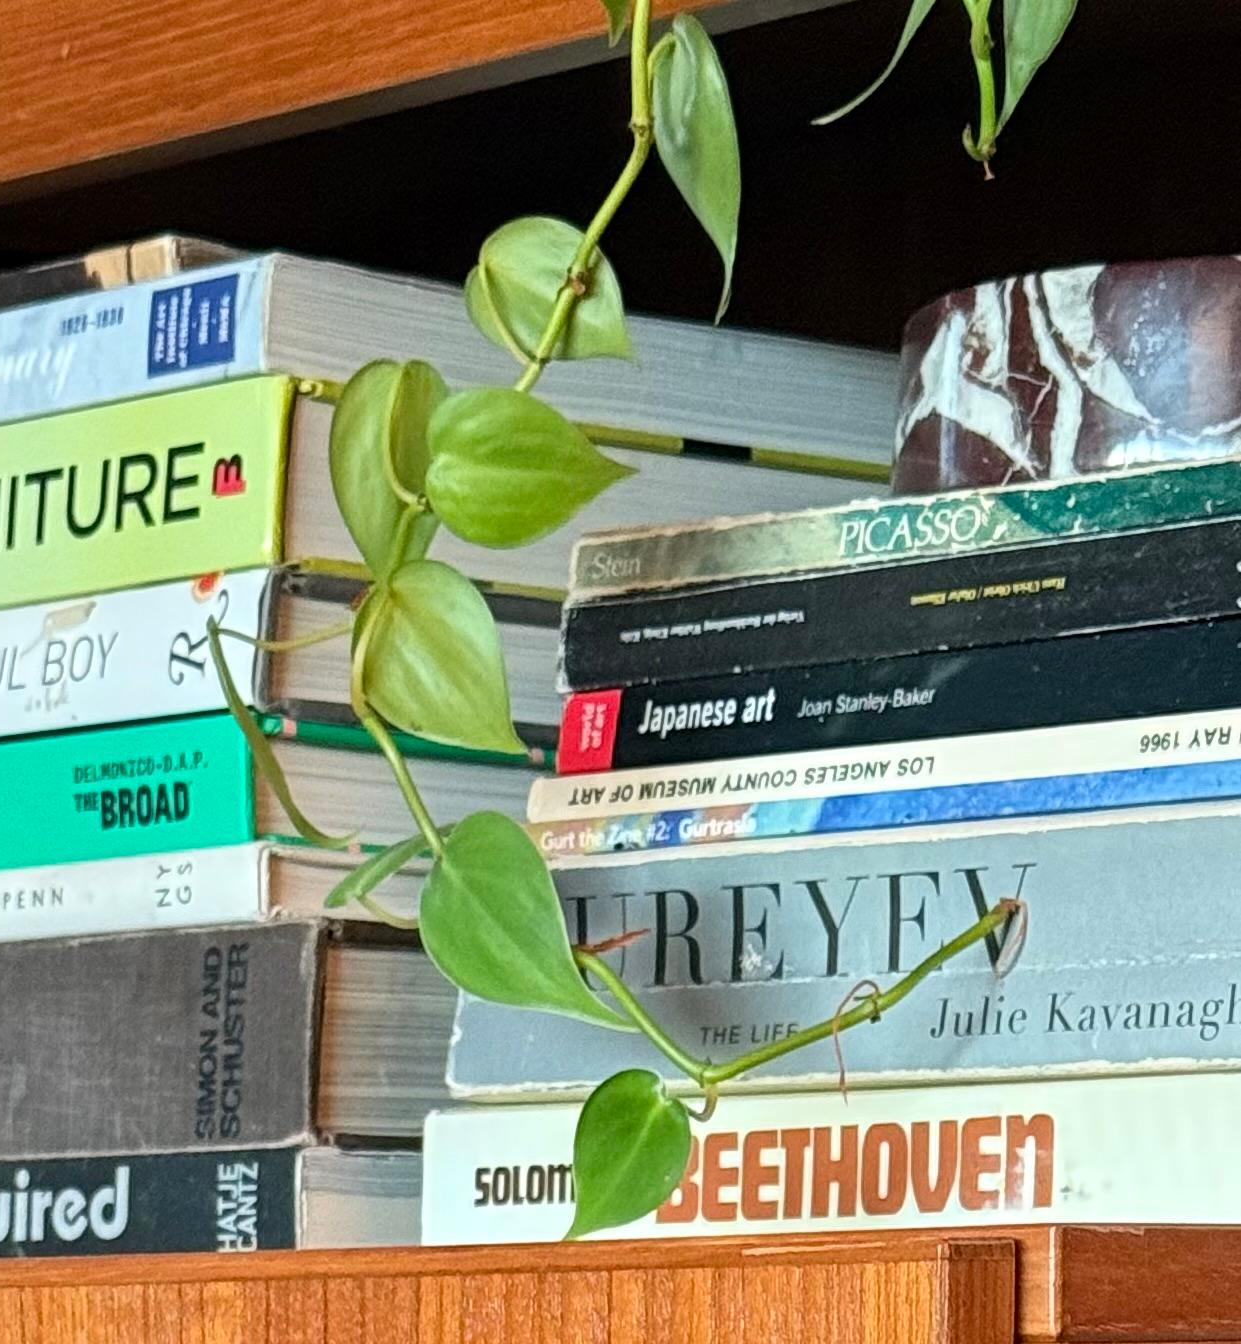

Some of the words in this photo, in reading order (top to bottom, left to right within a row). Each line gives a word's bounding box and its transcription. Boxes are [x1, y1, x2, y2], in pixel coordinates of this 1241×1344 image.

[838, 505, 982, 556] PICASSO
[591, 552, 641, 579] Stein
[41, 631, 120, 687] BOY
[638, 695, 736, 739] Japanese
[741, 686, 778, 723] art
[797, 697, 832, 719] Joan
[835, 686, 935, 715] Stanley-Baker
[1139, 730, 1180, 753] 1966
[1188, 726, 1232, 748] RAY
[721, 769, 797, 794] COUNTY
[803, 760, 890, 786] ANGELES
[897, 756, 935, 777] LOS
[568, 786, 606, 806] ART
[609, 783, 634, 802] OF
[640, 776, 717, 800] MUSEUM
[73, 792, 99, 813] THE
[100, 782, 190, 831] BROAD
[540, 830, 575, 851] Gurt
[579, 829, 602, 848] the
[2, 886, 66, 910] PENN
[565, 863, 1037, 990] UREYEV
[201, 946, 224, 1018] AND
[929, 996, 1028, 1039] Julie
[219, 941, 250, 1139] SCHUSTER
[700, 1025, 743, 1045] THE
[195, 1028, 219, 1140] SIMON
[473, 1163, 577, 1207] SOLOM
[216, 1162, 240, 1253] HATJE
[236, 1161, 259, 1253] CANTZ
